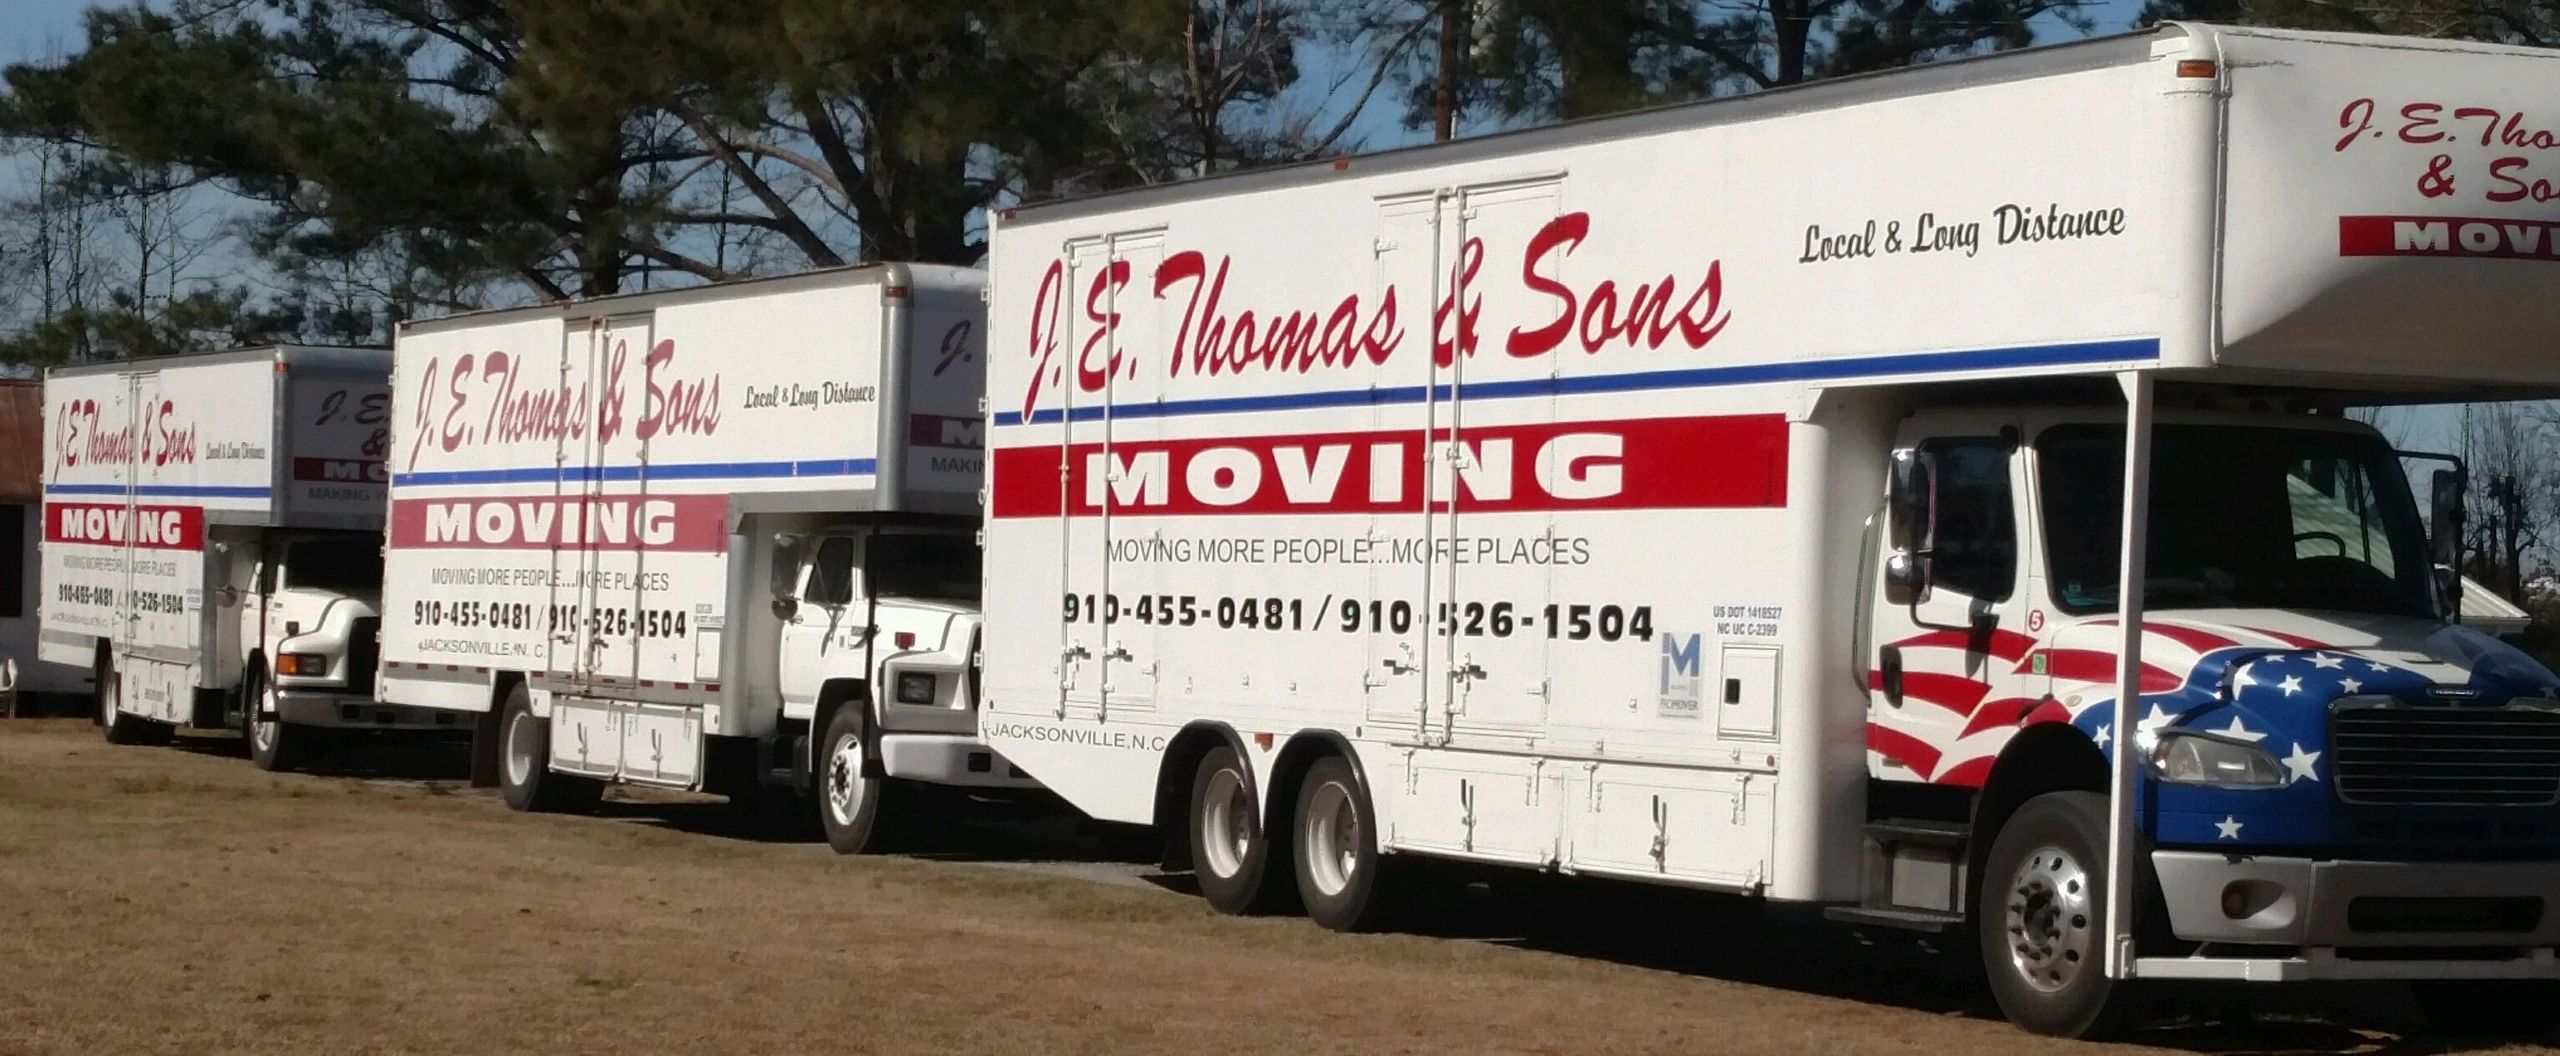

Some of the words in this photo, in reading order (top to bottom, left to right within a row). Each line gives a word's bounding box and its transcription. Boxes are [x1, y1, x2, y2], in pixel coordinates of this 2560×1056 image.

[2335, 98, 2383, 152] J.
[2398, 103, 2457, 143] E.
[2454, 107, 2560, 149] Tho
[2418, 154, 2455, 198] &
[2486, 157, 2560, 203] So
[1799, 220, 1876, 264] Local
[1884, 220, 1901, 254] &
[1910, 212, 1980, 258] Long
[1993, 203, 2126, 245] Distance
[1022, 258, 1063, 426] J.
[1078, 260, 1137, 392] E.
[1154, 250, 1405, 379] Thomas
[1434, 236, 1484, 369] &
[1505, 211, 1732, 358] Sons
[933, 320, 972, 377] J.
[483, 350, 588, 444] Thomas
[598, 338, 626, 446] &
[636, 339, 721, 440] Sons
[744, 386, 779, 409] Local
[782, 388, 788, 401] &
[789, 383, 819, 411] Long
[822, 381, 876, 405] Distance
[156, 400, 196, 467] Sons
[1086, 433, 1624, 507] MOVING
[425, 500, 675, 545] MOVING
[1106, 538, 1191, 563] MOVING
[1198, 539, 1265, 563] MORE
[1477, 537, 1590, 565] PLACES
[615, 572, 669, 591] PLACES
[1714, 606, 1726, 618] US
[1727, 606, 1746, 618] DOT
[1717, 623, 1731, 635] NC
[1733, 623, 1746, 635] UC
[1748, 624, 1778, 636] C-2399
[2031, 612, 2042, 628] 5
